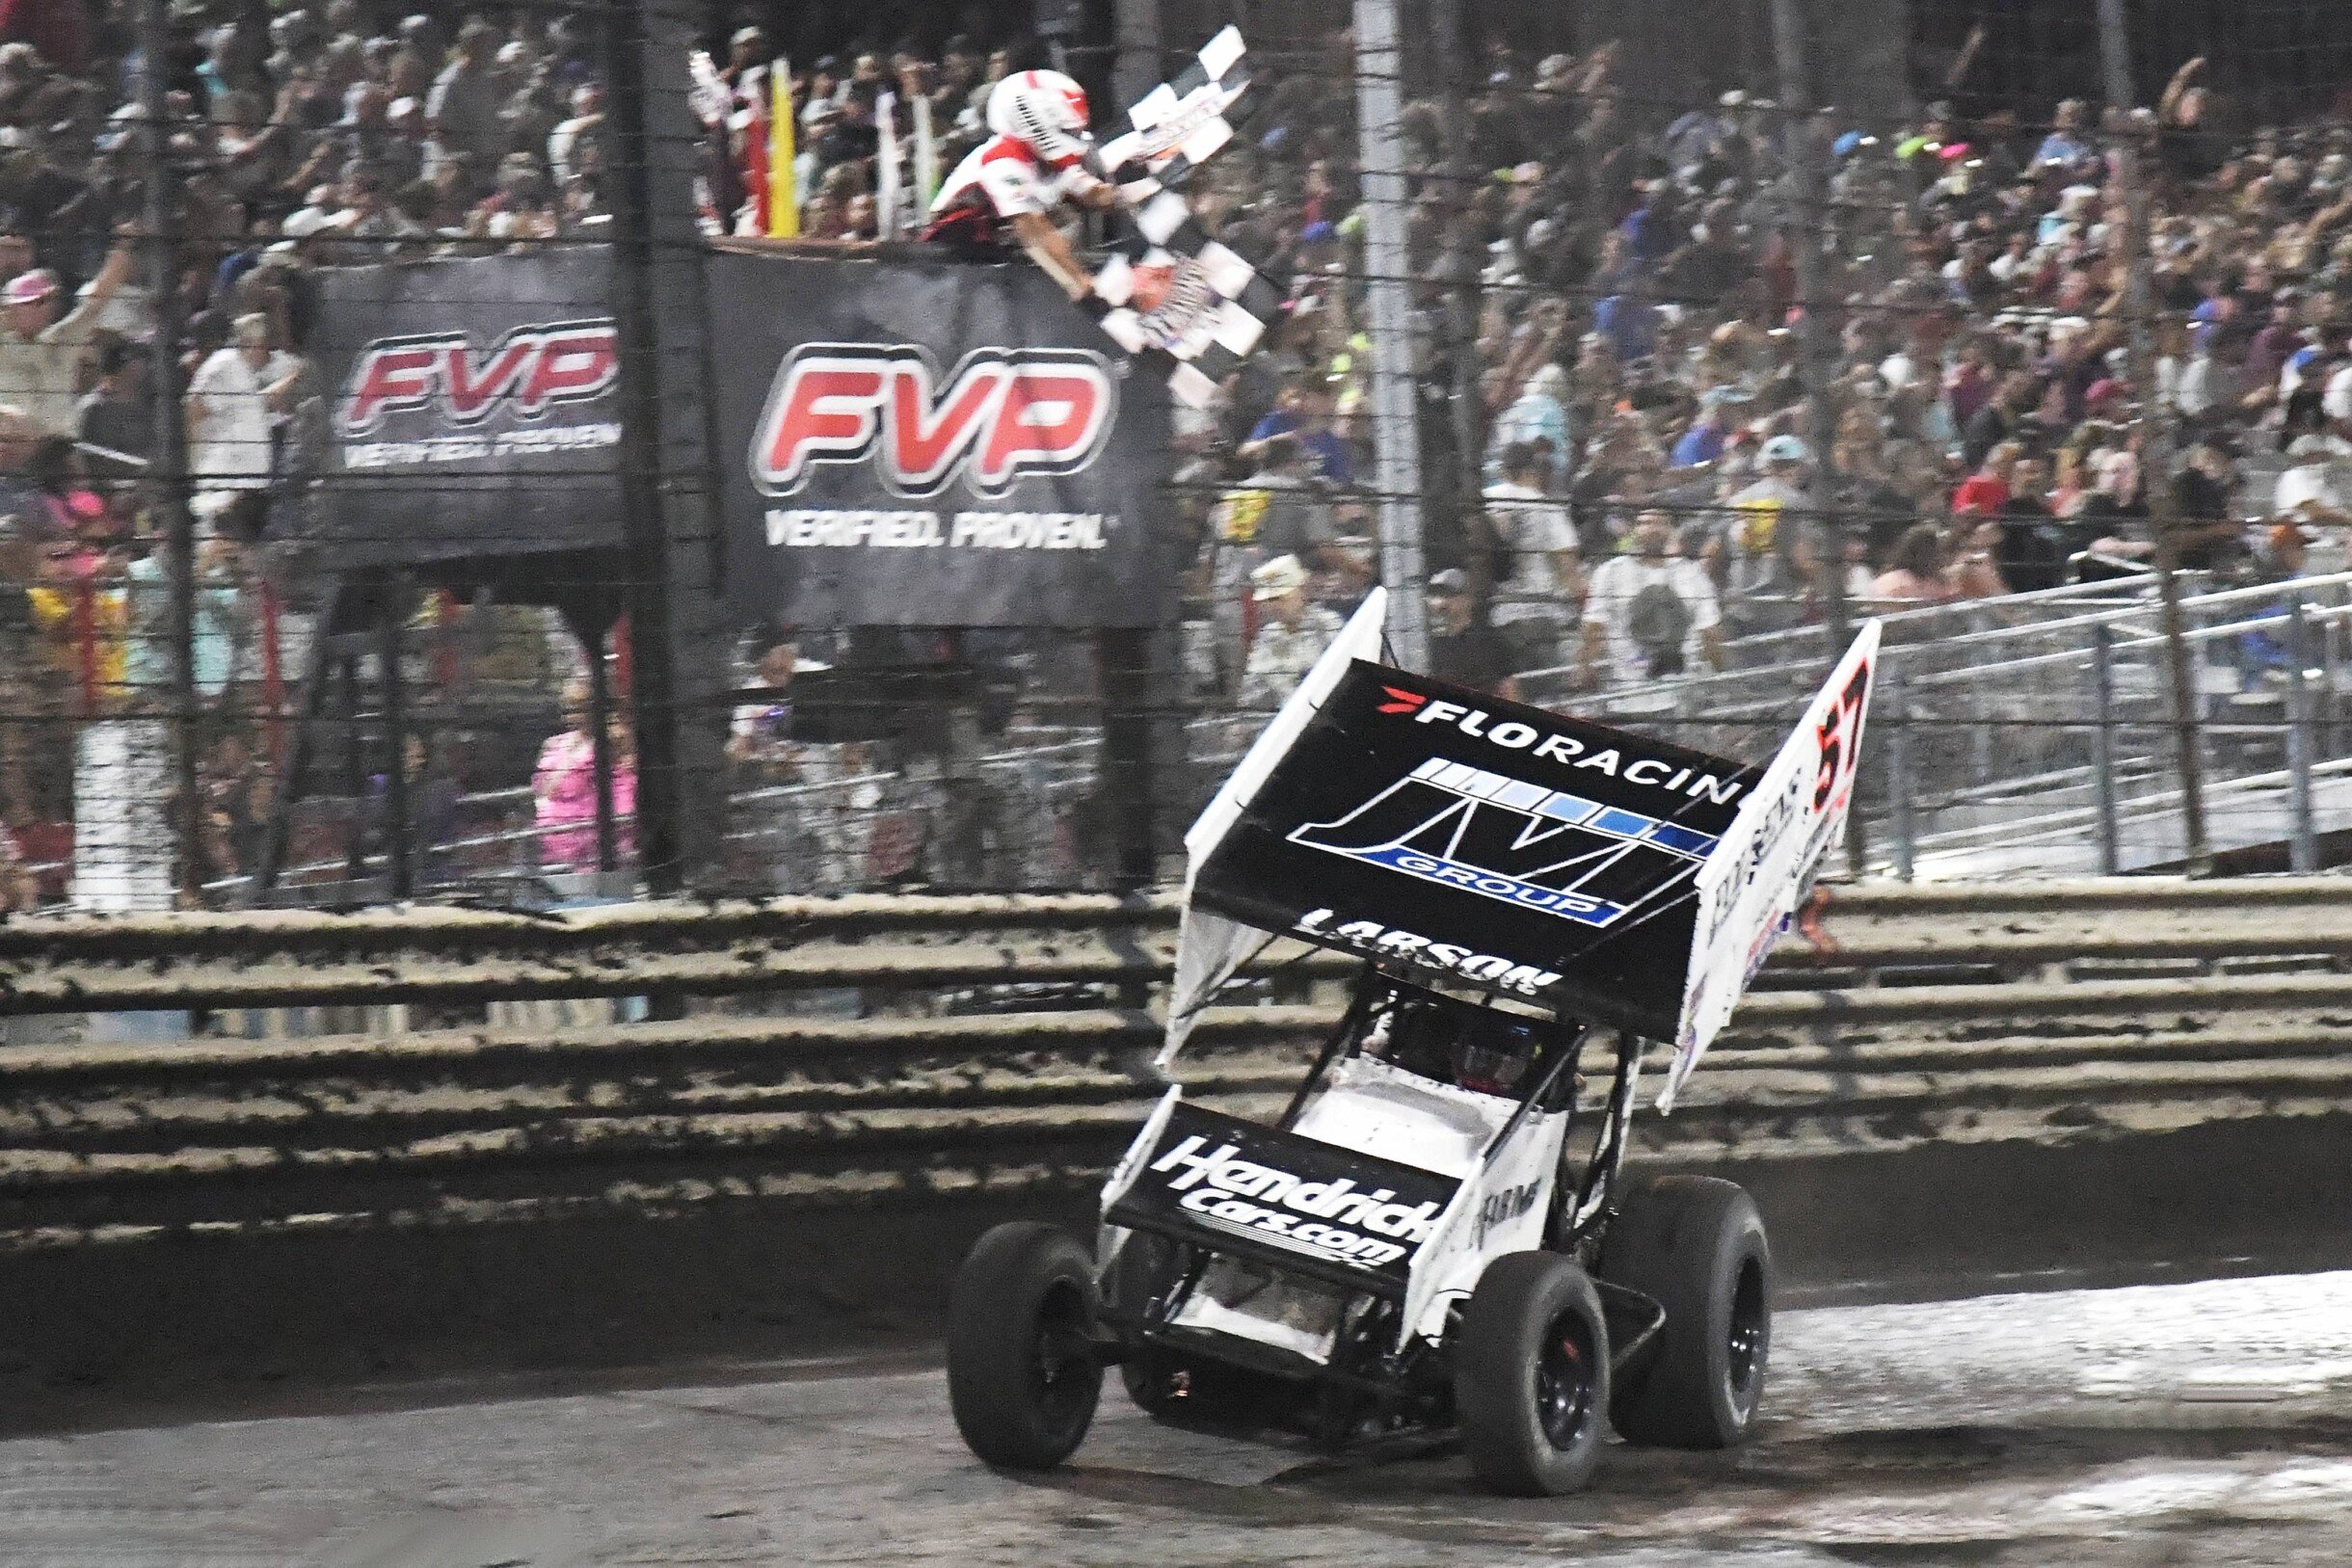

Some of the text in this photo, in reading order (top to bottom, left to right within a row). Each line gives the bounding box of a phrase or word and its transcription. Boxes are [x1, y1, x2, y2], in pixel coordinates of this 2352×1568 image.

[335, 324, 620, 432] FVP
[756, 354, 1113, 489] FVP
[1414, 700, 1746, 811] FLORACIN
[1812, 657, 1869, 813] 57
[1396, 856, 1596, 915] GROUP
[1292, 908, 1564, 995] LARSON
[1151, 1134, 1445, 1243] Hendrick
[1179, 1187, 1406, 1265] Cars.com
